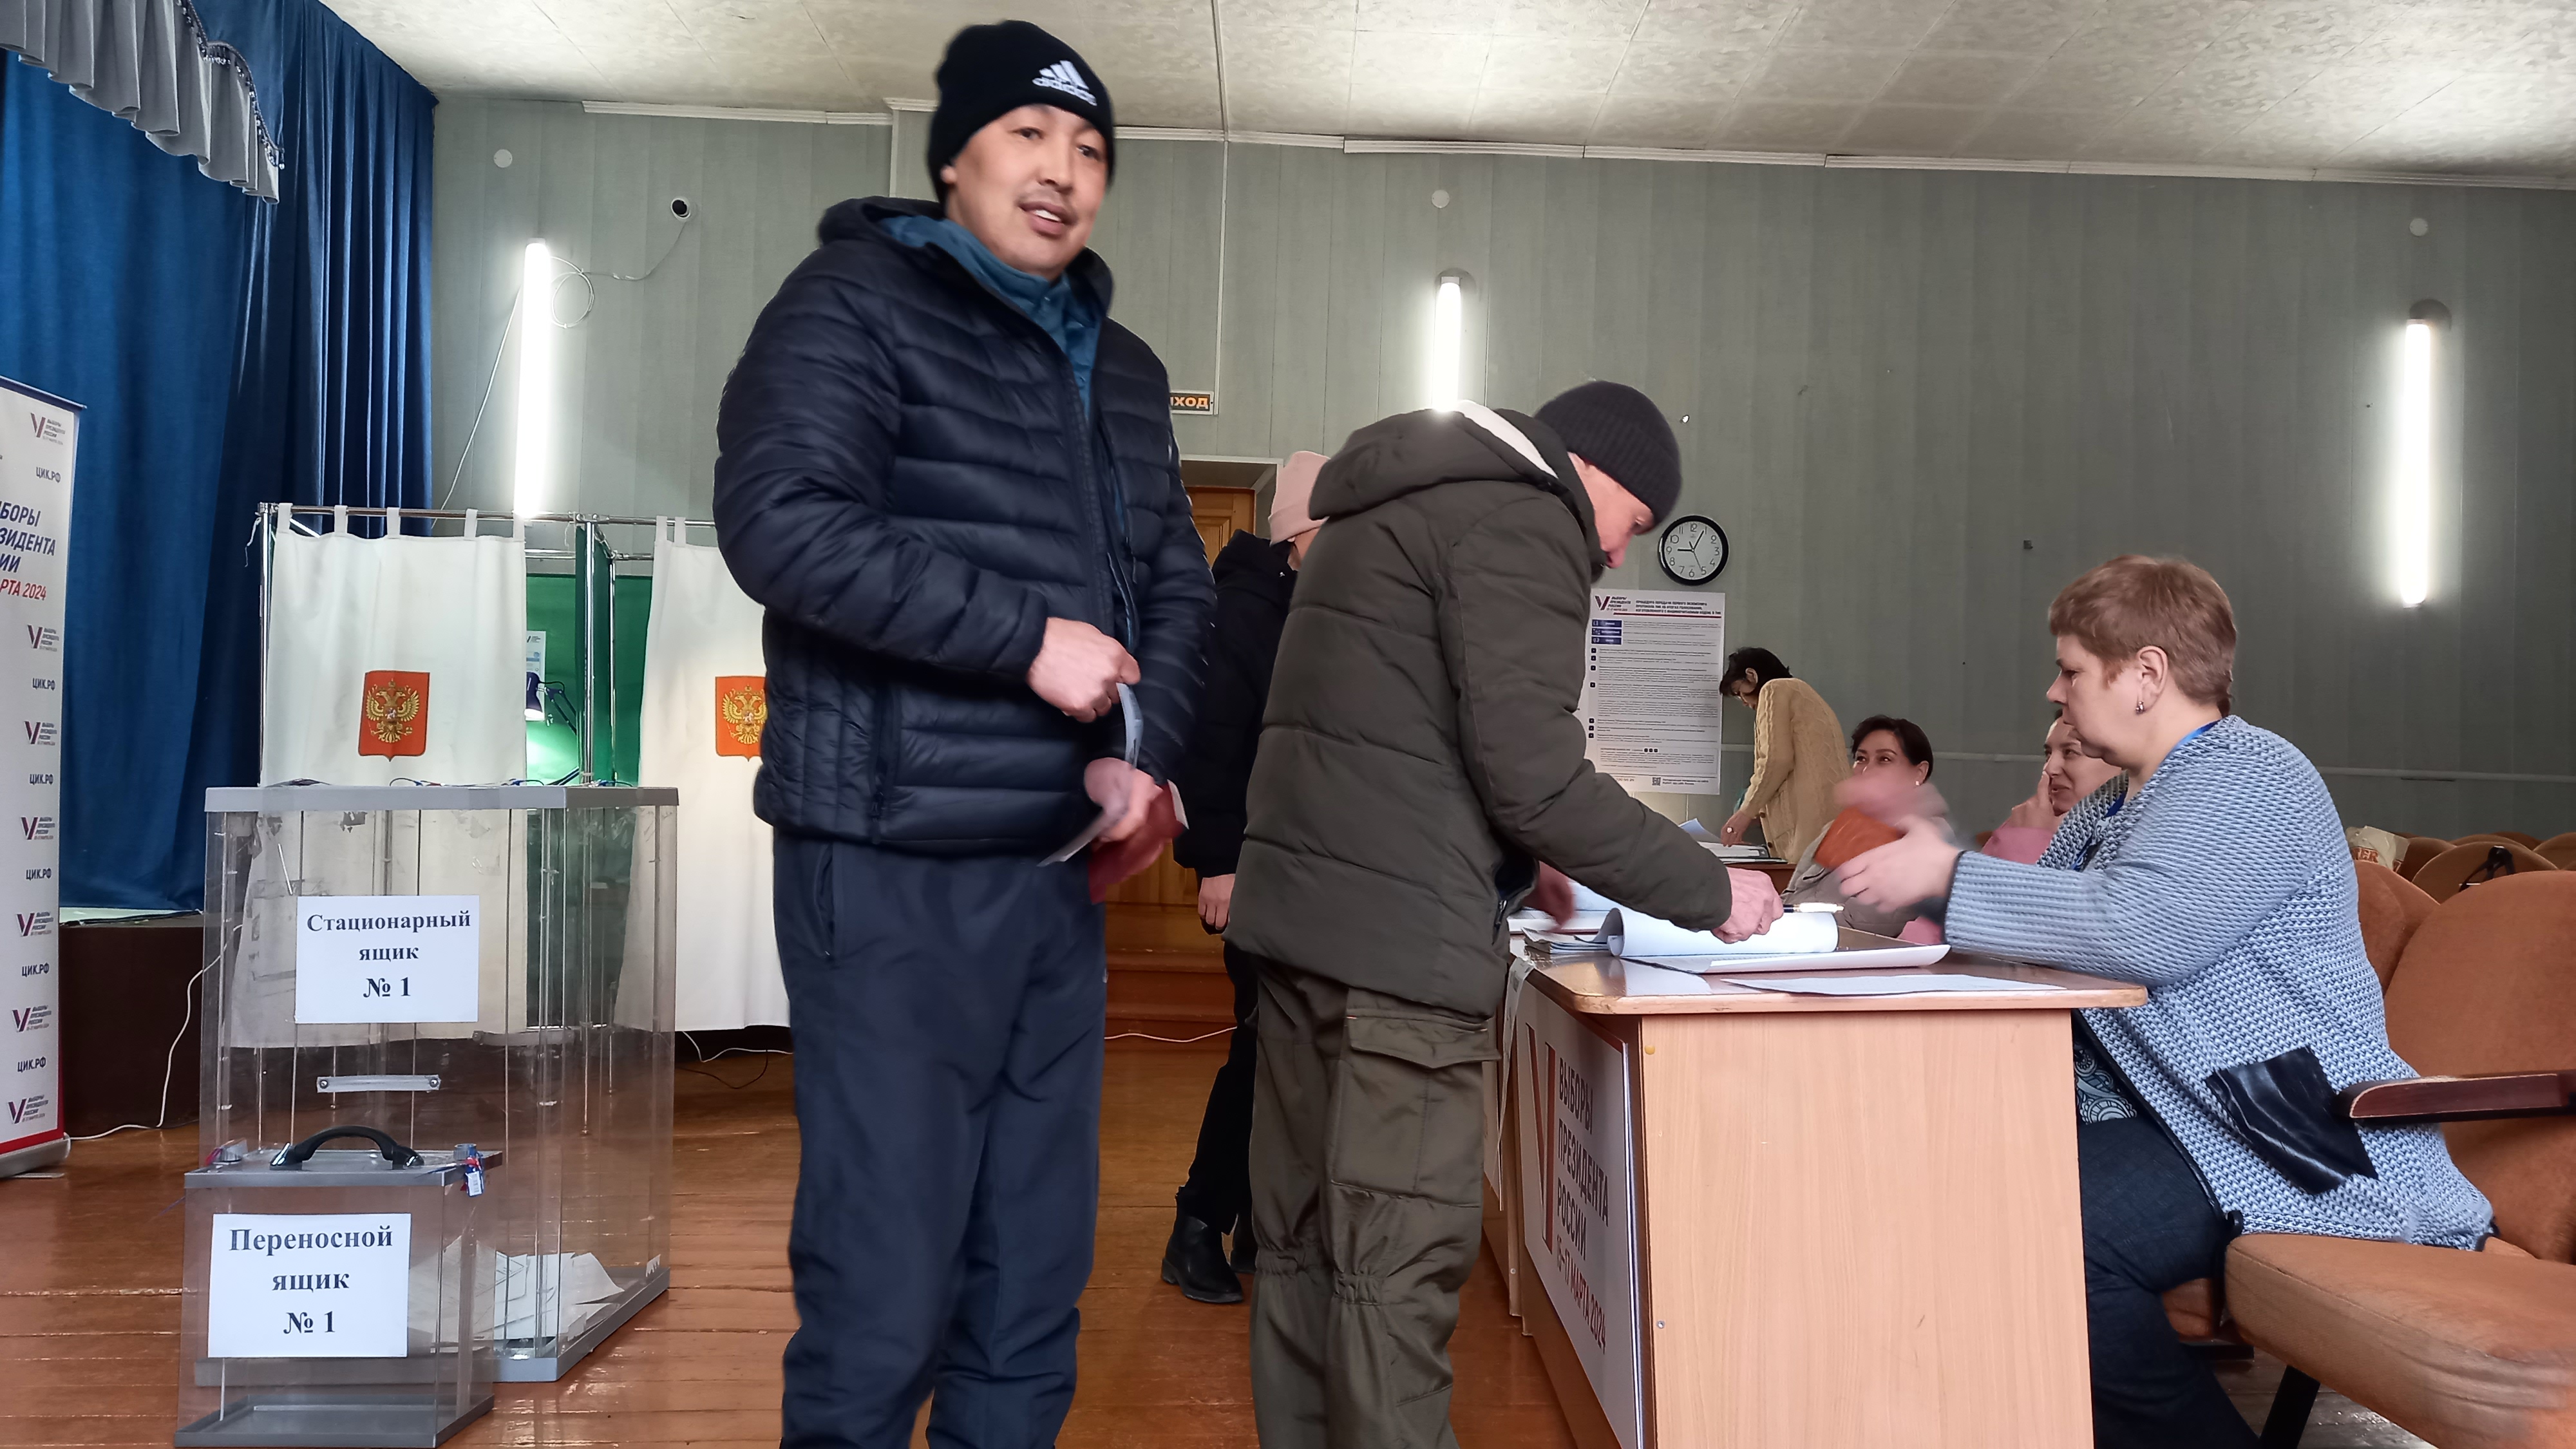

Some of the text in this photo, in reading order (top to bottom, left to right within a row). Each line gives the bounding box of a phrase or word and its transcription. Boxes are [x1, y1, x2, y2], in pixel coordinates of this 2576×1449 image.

[0, 500, 41, 527] БОРЫ
[1679, 526, 1683, 535] 11
[1690, 523, 1698, 532] 12
[1705, 526, 1707, 535] 1
[0, 527, 56, 556] ЗИДЕНТА
[1670, 535, 1680, 544] 10
[1710, 535, 1717, 544] 2
[1666, 545, 1672, 554] 9
[1714, 547, 1720, 556] 3
[1669, 556, 1676, 566] 8
[1678, 565, 1685, 574] 7
[1689, 569, 1695, 578] 6
[1701, 566, 1707, 575] 5
[23, 583, 46, 600] 2024
[307, 909, 471, 933] Стационарный
[359, 947, 419, 963] ящик
[22, 962, 50, 978] ЦИК.РФ
[363, 977, 411, 998] № 1
[17, 1056, 46, 1073] ЦИК.РФ
[1559, 1057, 1593, 1135] ВЫБОРЫ
[1558, 1118, 1609, 1227] ПРЕЗИДЕНТА
[1557, 1177, 1586, 1261] РОССИИ
[229, 1225, 393, 1256] Переносной
[272, 1273, 350, 1293] ящик
[1571, 1258, 1589, 1325] МАРТА
[1590, 1294, 1606, 1354] 2024
[283, 1311, 336, 1334] № 1
